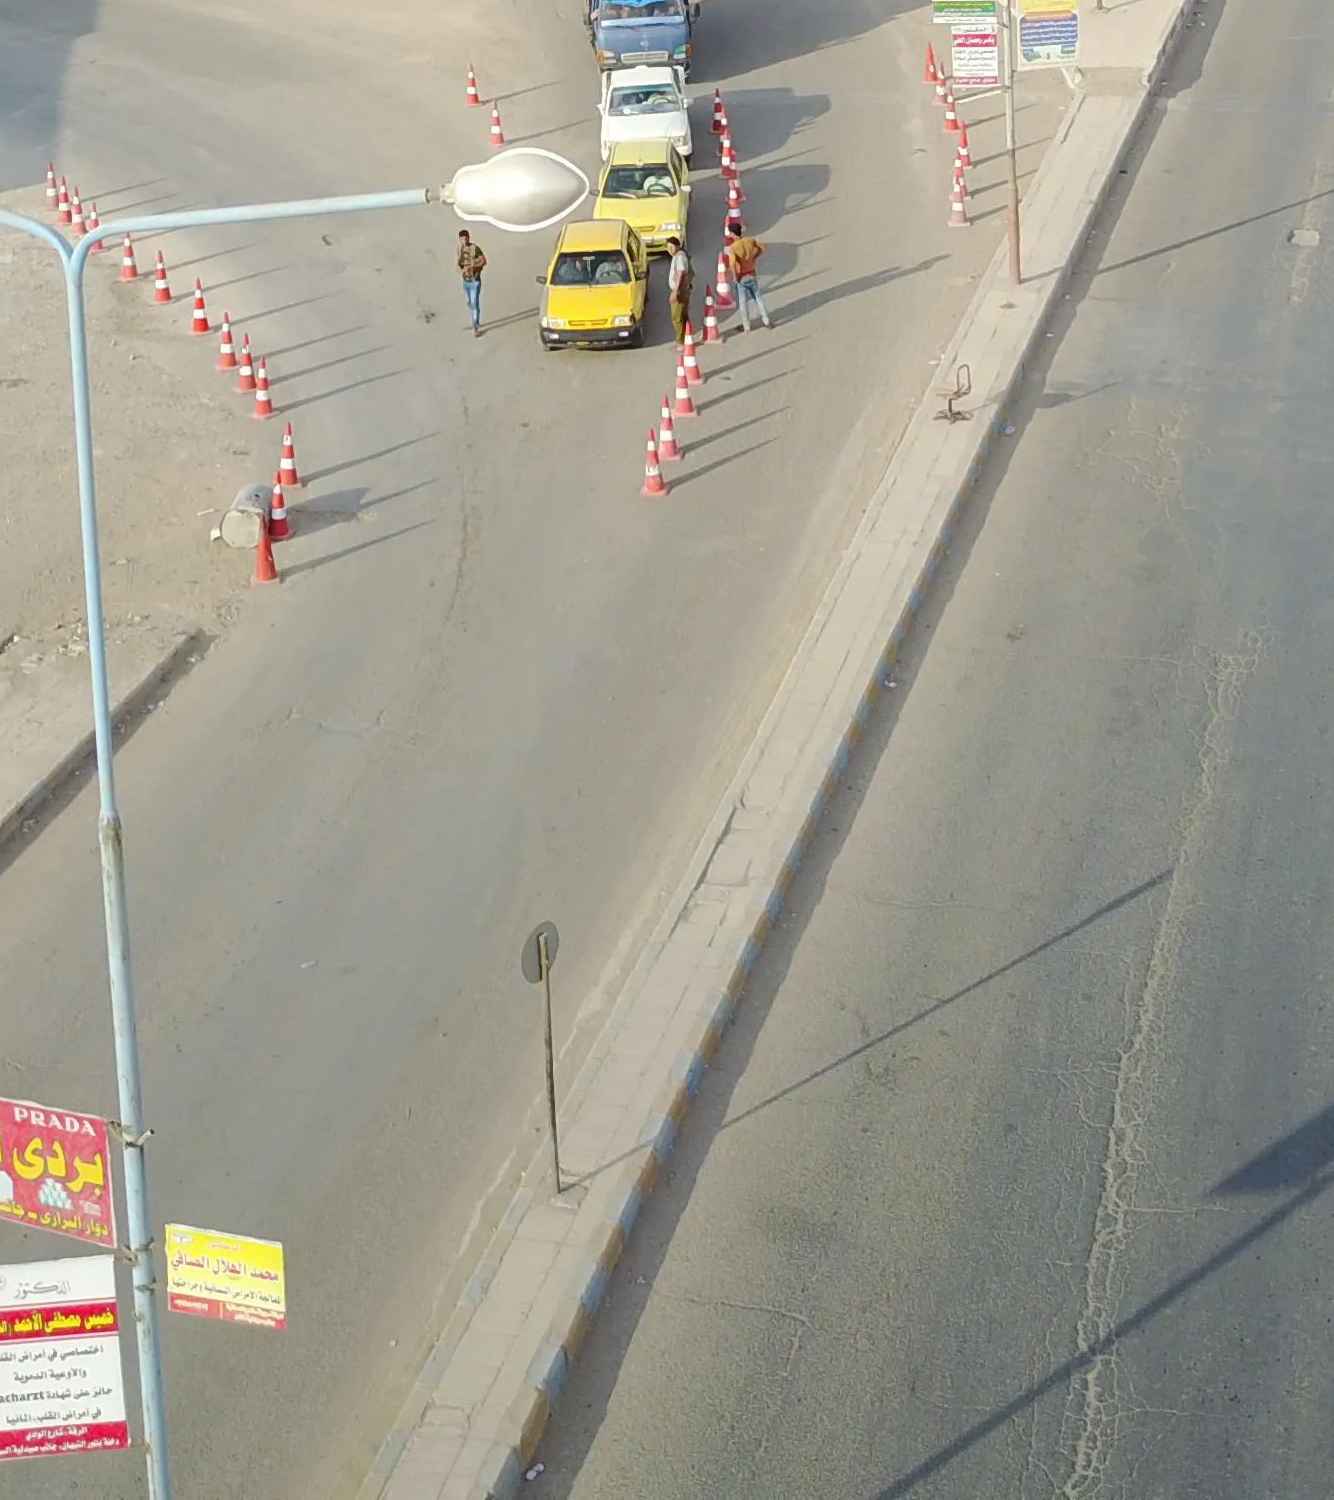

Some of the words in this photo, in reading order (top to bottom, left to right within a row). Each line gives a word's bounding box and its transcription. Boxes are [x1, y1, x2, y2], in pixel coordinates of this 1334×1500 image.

[13, 1106, 96, 1137] PRADA
[84, 1218, 109, 1237] دوار
[171, 1249, 209, 1271] الصافي
[250, 1267, 279, 1281] محمد
[14, 1279, 71, 1299] الدكتور
[84, 1307, 114, 1330] خميس
[13, 1371, 47, 1385] الدموية
[46, 1387, 71, 1400] شهادة
[37, 1410, 60, 1424] القلب
